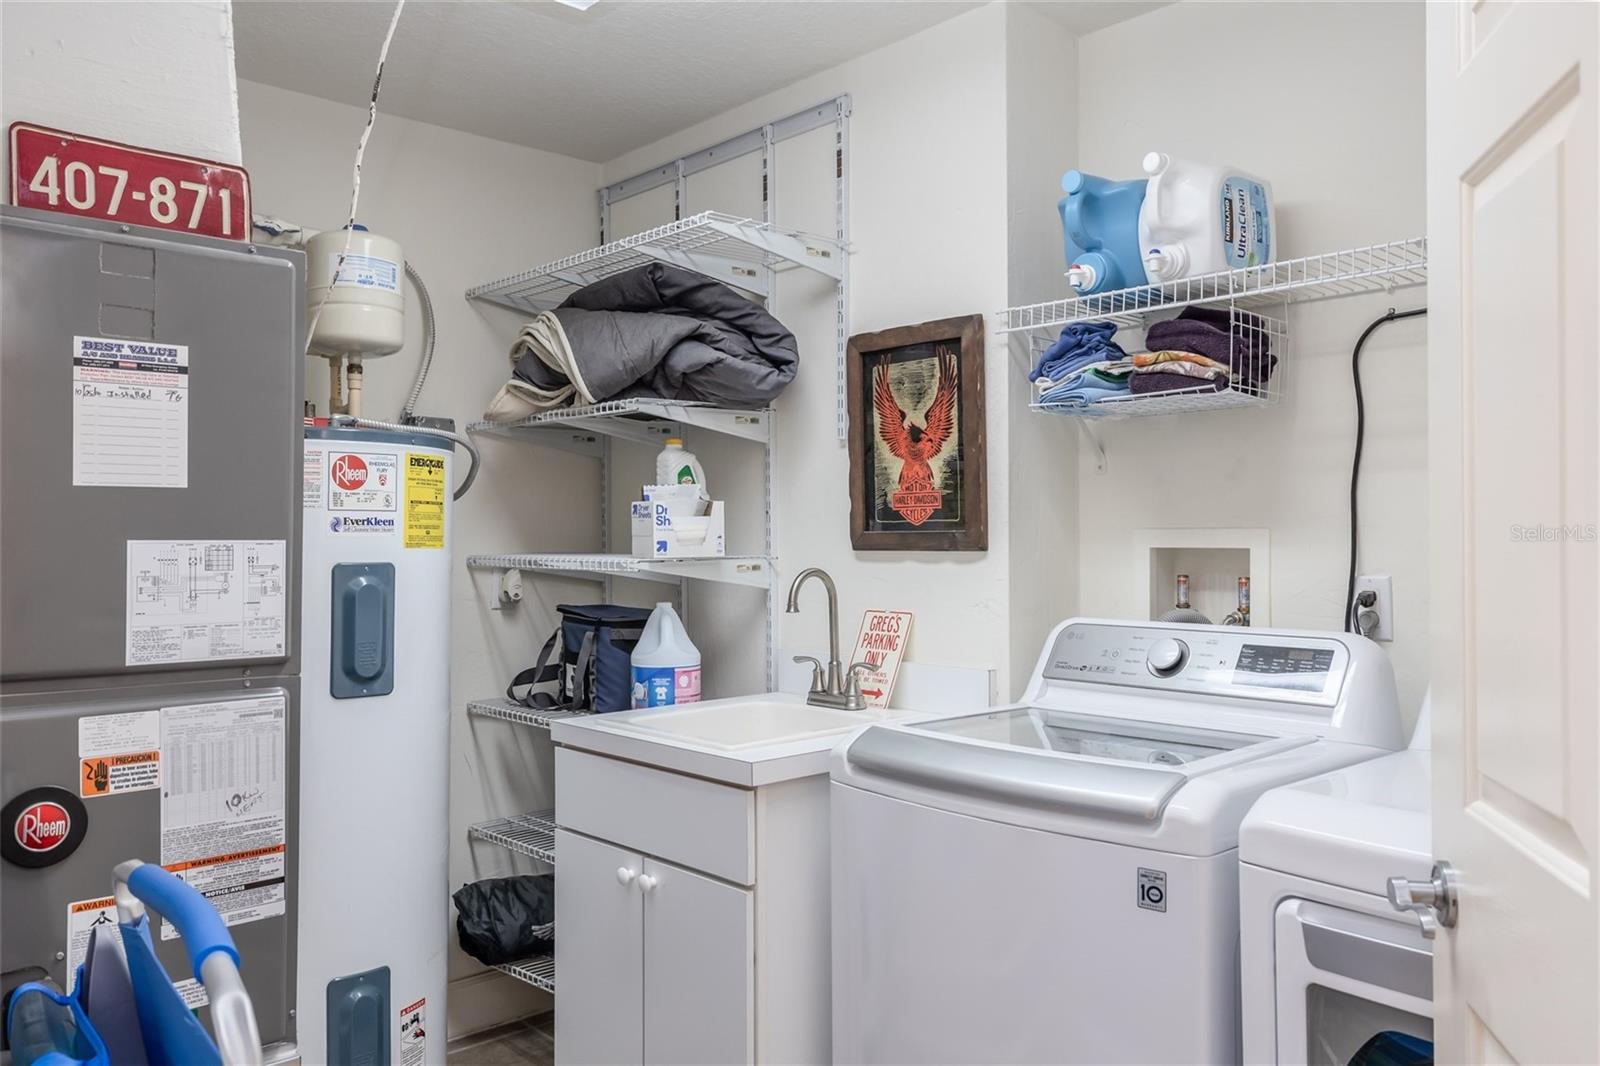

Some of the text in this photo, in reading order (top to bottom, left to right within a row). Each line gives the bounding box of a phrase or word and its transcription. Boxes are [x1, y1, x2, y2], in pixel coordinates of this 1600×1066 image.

[30, 156, 231, 234] 407-871
[1237, 188, 1246, 258] UltraClean
[81, 341, 177, 358] BEST VALUE
[336, 456, 367, 486] Rheem
[905, 481, 928, 491] MOTOR
[638, 504, 649, 512] Dryer
[906, 508, 928, 520] CYCLES
[343, 517, 394, 526] EverKleen
[869, 614, 902, 633] GREG'S
[861, 632, 900, 652] PARKING
[864, 650, 888, 668] ONLY
[23, 807, 66, 844] Rheem
[191, 846, 281, 867] WARNING AVERTISSEMENT
[1141, 884, 1163, 904] 10
[83, 899, 115, 911] WARNI
